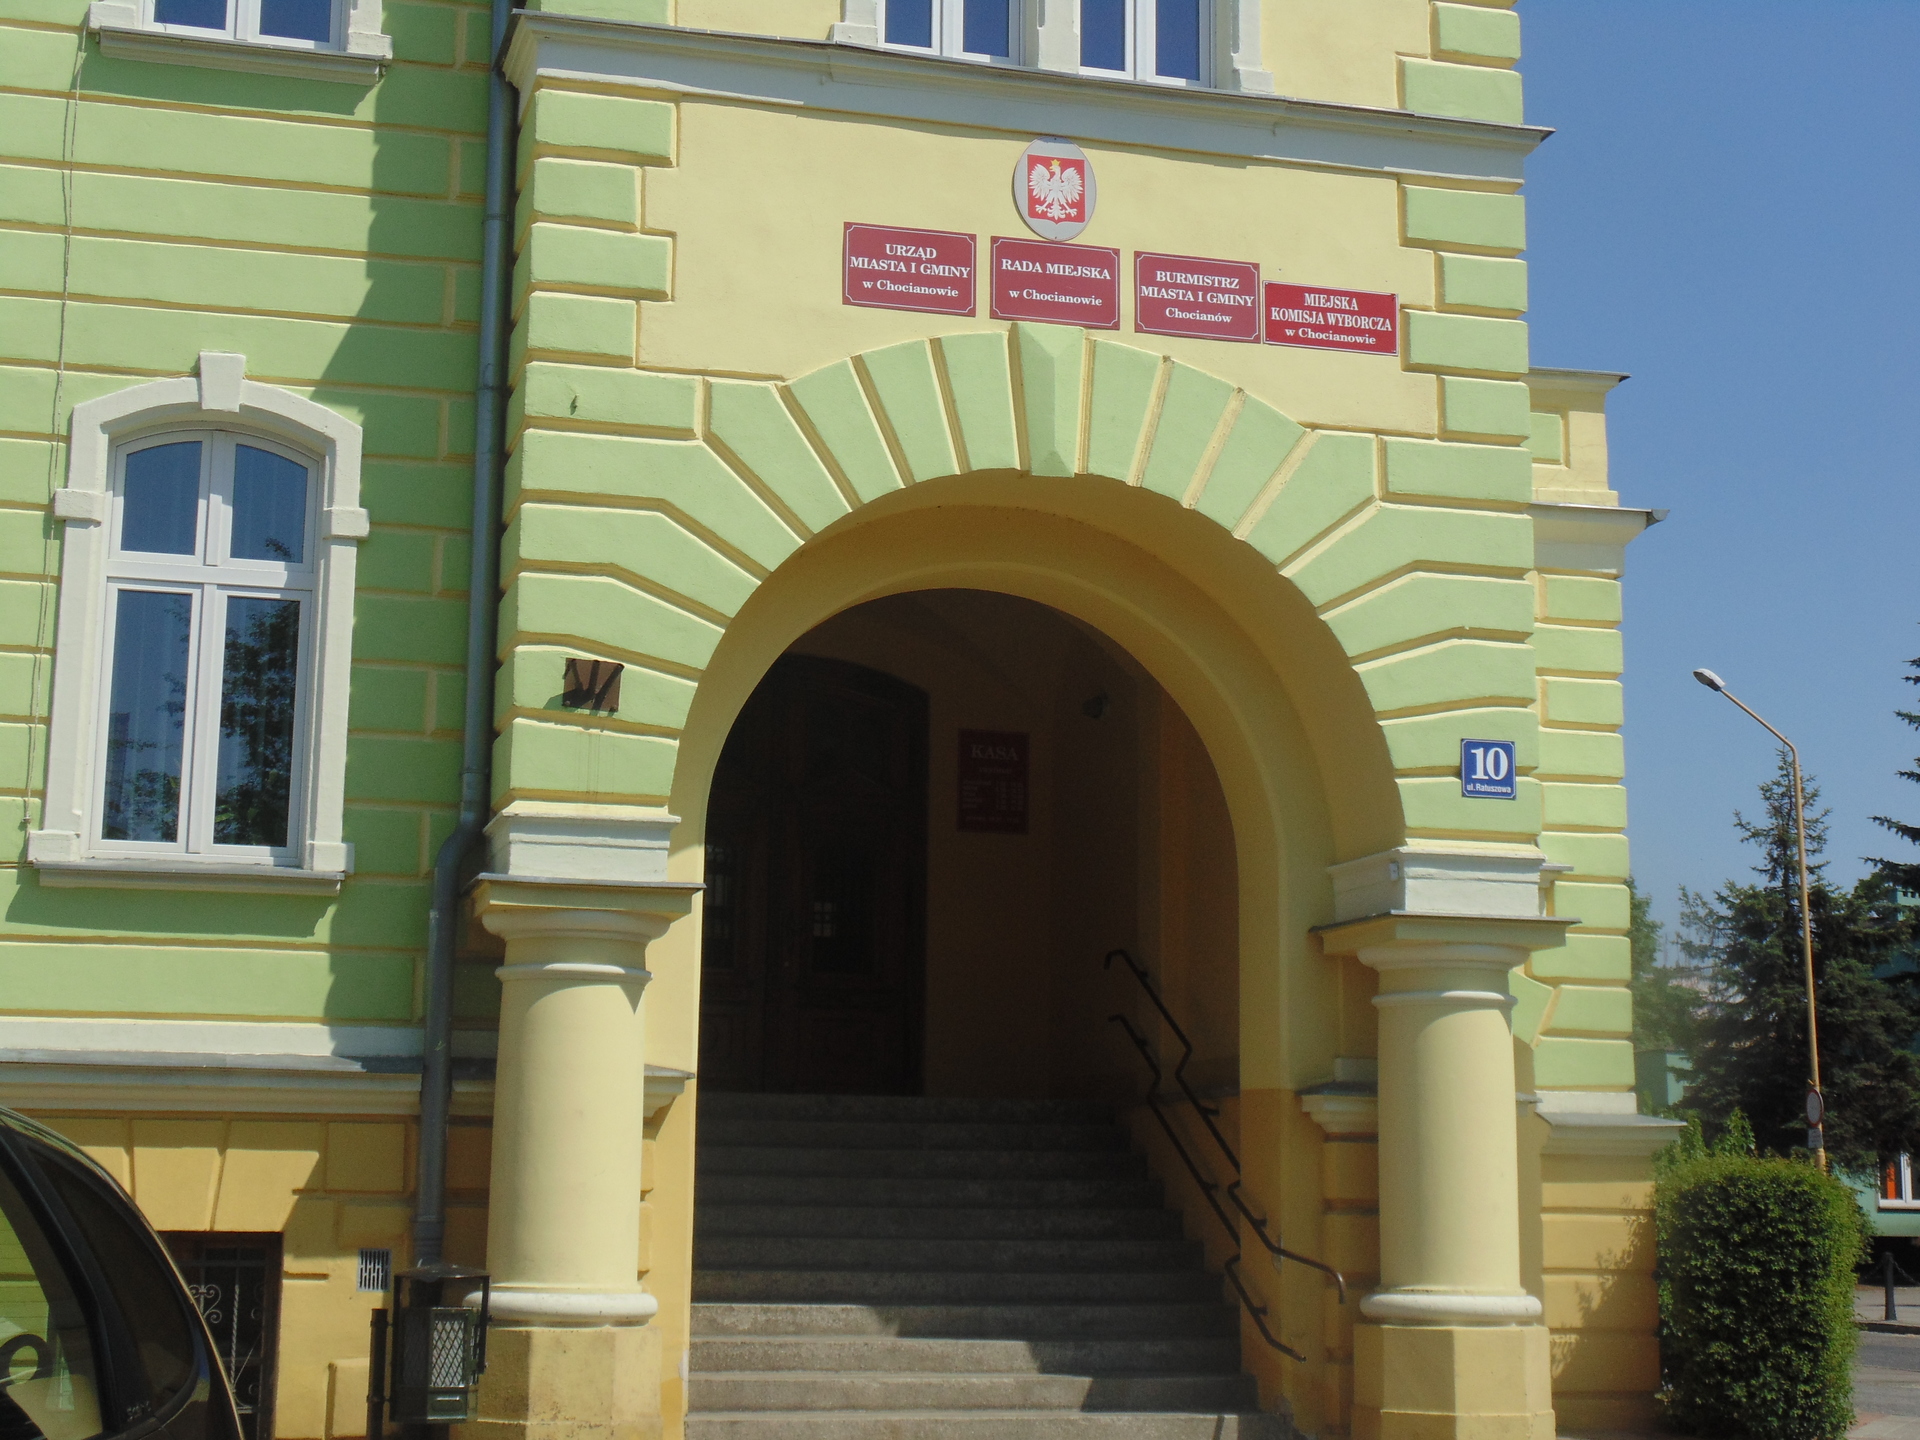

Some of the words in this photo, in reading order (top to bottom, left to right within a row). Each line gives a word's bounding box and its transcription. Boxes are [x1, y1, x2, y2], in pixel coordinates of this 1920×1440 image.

[885, 243, 937, 261] URZĄD
[850, 256, 906, 273] MIASTA
[910, 262, 917, 274] I
[920, 263, 971, 279] GMINY
[1001, 258, 1043, 274] RADA
[1045, 263, 1111, 280] MIEJSKA
[862, 281, 874, 289] w
[877, 279, 959, 297] Chocianowie
[1155, 270, 1240, 289] BURMISTRZ
[1008, 289, 1020, 299] w
[1022, 288, 1102, 306] Chocianowie
[1141, 285, 1195, 302] MIASTA
[1197, 290, 1204, 303] I
[1207, 292, 1255, 307] GMINY
[1304, 292, 1358, 311] MIEJSKA
[1165, 307, 1232, 323] Chocianów
[1271, 307, 1325, 325] KOMISJA
[1327, 312, 1392, 332] WYBORCZA
[1285, 328, 1296, 337] w
[1298, 327, 1376, 345] Chocianowie
[970, 743, 1019, 761] KASA
[1470, 747, 1508, 780] 10
